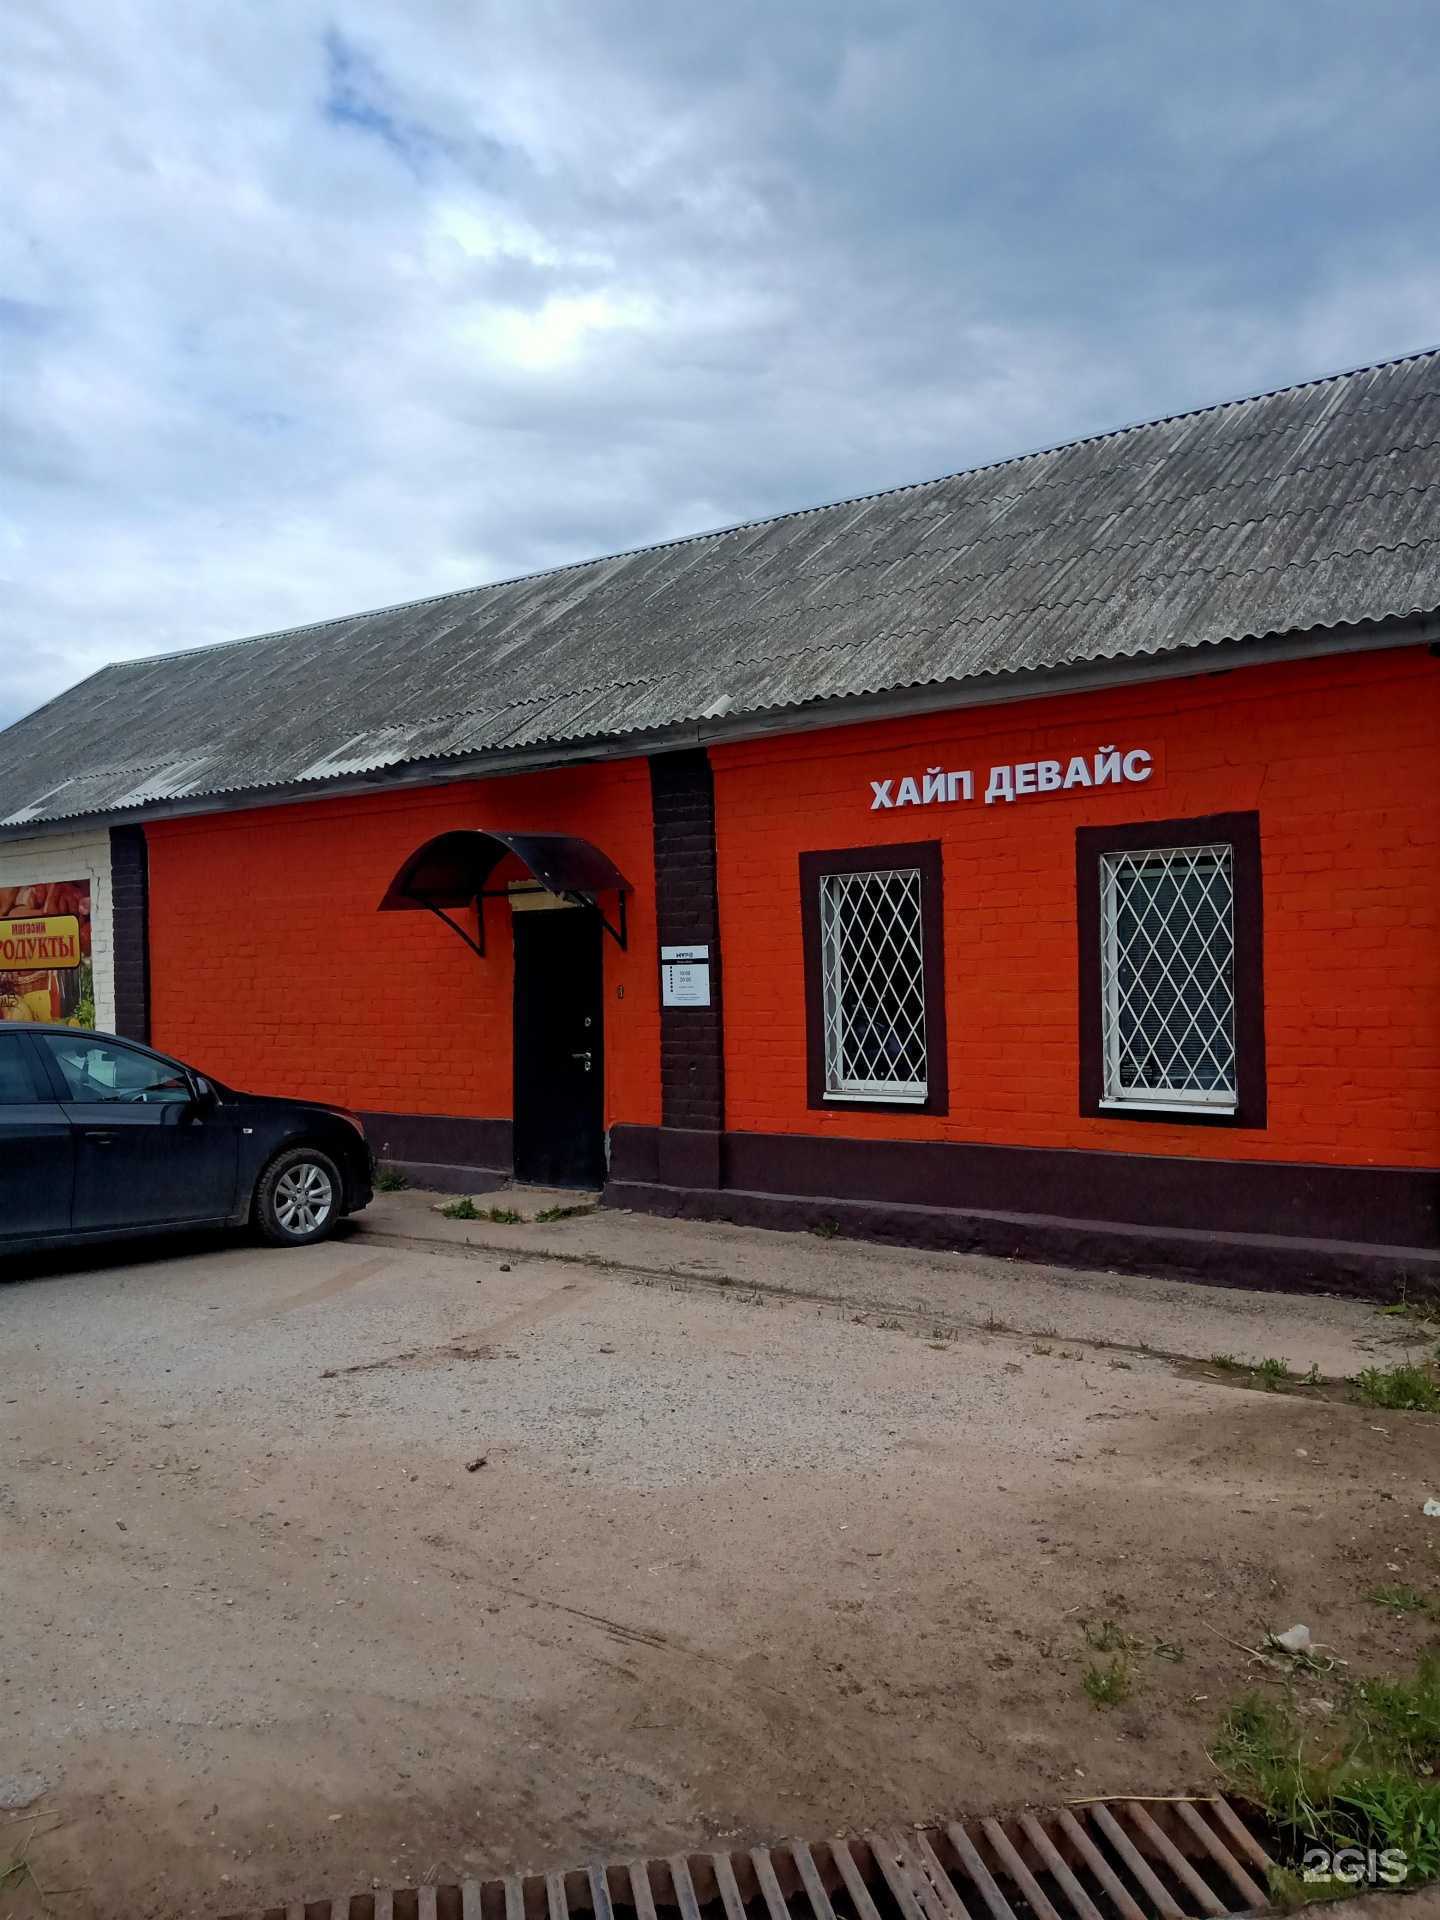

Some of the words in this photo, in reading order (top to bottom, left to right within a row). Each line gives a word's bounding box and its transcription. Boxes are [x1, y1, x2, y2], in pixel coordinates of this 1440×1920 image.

[870, 767, 974, 810] ХАЙП
[985, 745, 1153, 804] ДЕВАЙС
[0, 935, 75, 960] ОДУКТЫ
